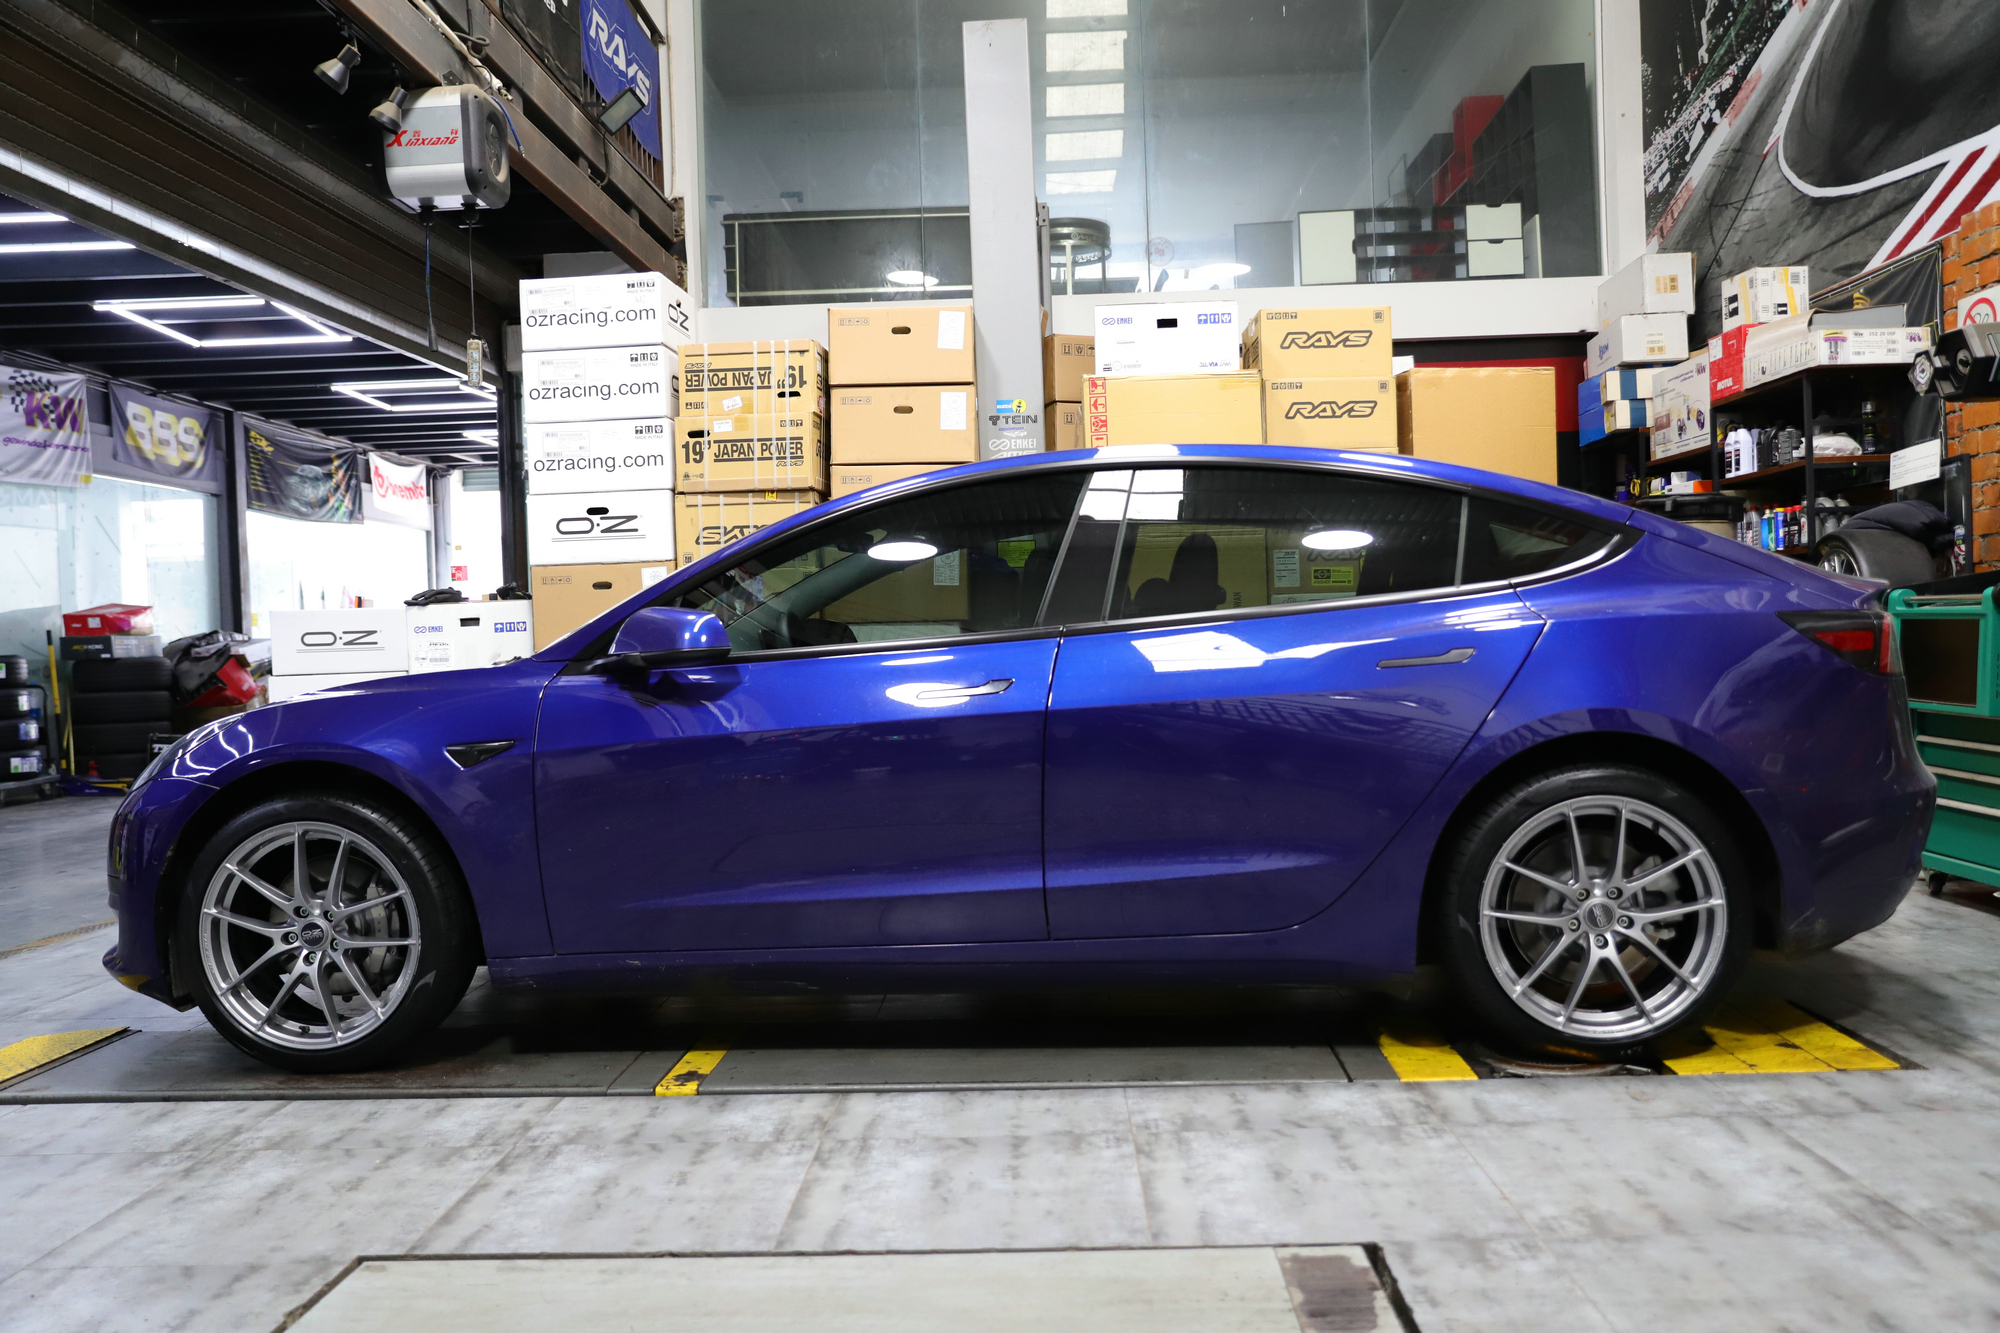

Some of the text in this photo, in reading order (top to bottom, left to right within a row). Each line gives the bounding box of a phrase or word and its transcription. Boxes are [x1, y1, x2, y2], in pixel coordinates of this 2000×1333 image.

[526, 307, 656, 328] ozracing.com
[1280, 330, 1373, 350] RAYS
[529, 381, 660, 401] ozracing.com
[1716, 377, 1734, 391] MOTUL
[24, 390, 84, 435] KW
[1002, 415, 1038, 425] TEIN
[1285, 400, 1378, 420] RAYS
[126, 401, 204, 466] BBS
[1011, 438, 1037, 449] ENKEI
[714, 443, 755, 458] JAPAN
[761, 441, 804, 456] POWER
[534, 454, 664, 473] ozracing.com
